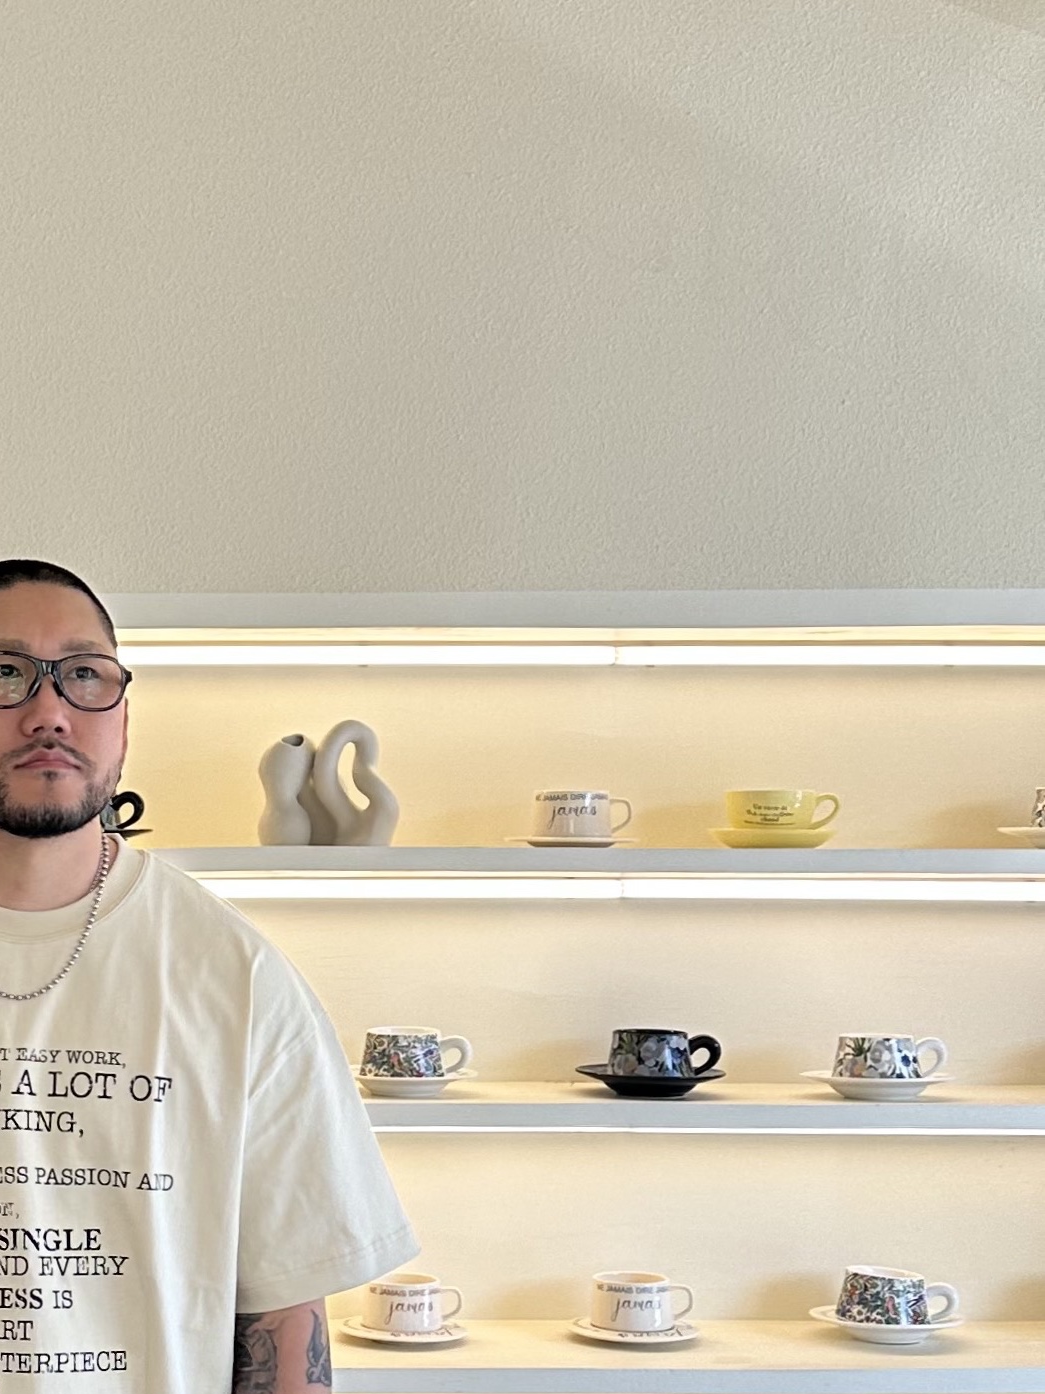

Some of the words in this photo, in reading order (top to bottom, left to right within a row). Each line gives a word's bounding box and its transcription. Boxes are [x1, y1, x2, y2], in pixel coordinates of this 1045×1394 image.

[16, 1047, 61, 1062] EASY
[66, 1050, 126, 1068] WORK,
[11, 1069, 37, 1096] A
[47, 1071, 116, 1099] LOT
[129, 1075, 173, 1102] OF
[35, 1167, 131, 1188] PASSION
[38, 1256, 130, 1276] EVERY
[52, 1290, 73, 1309] IS
